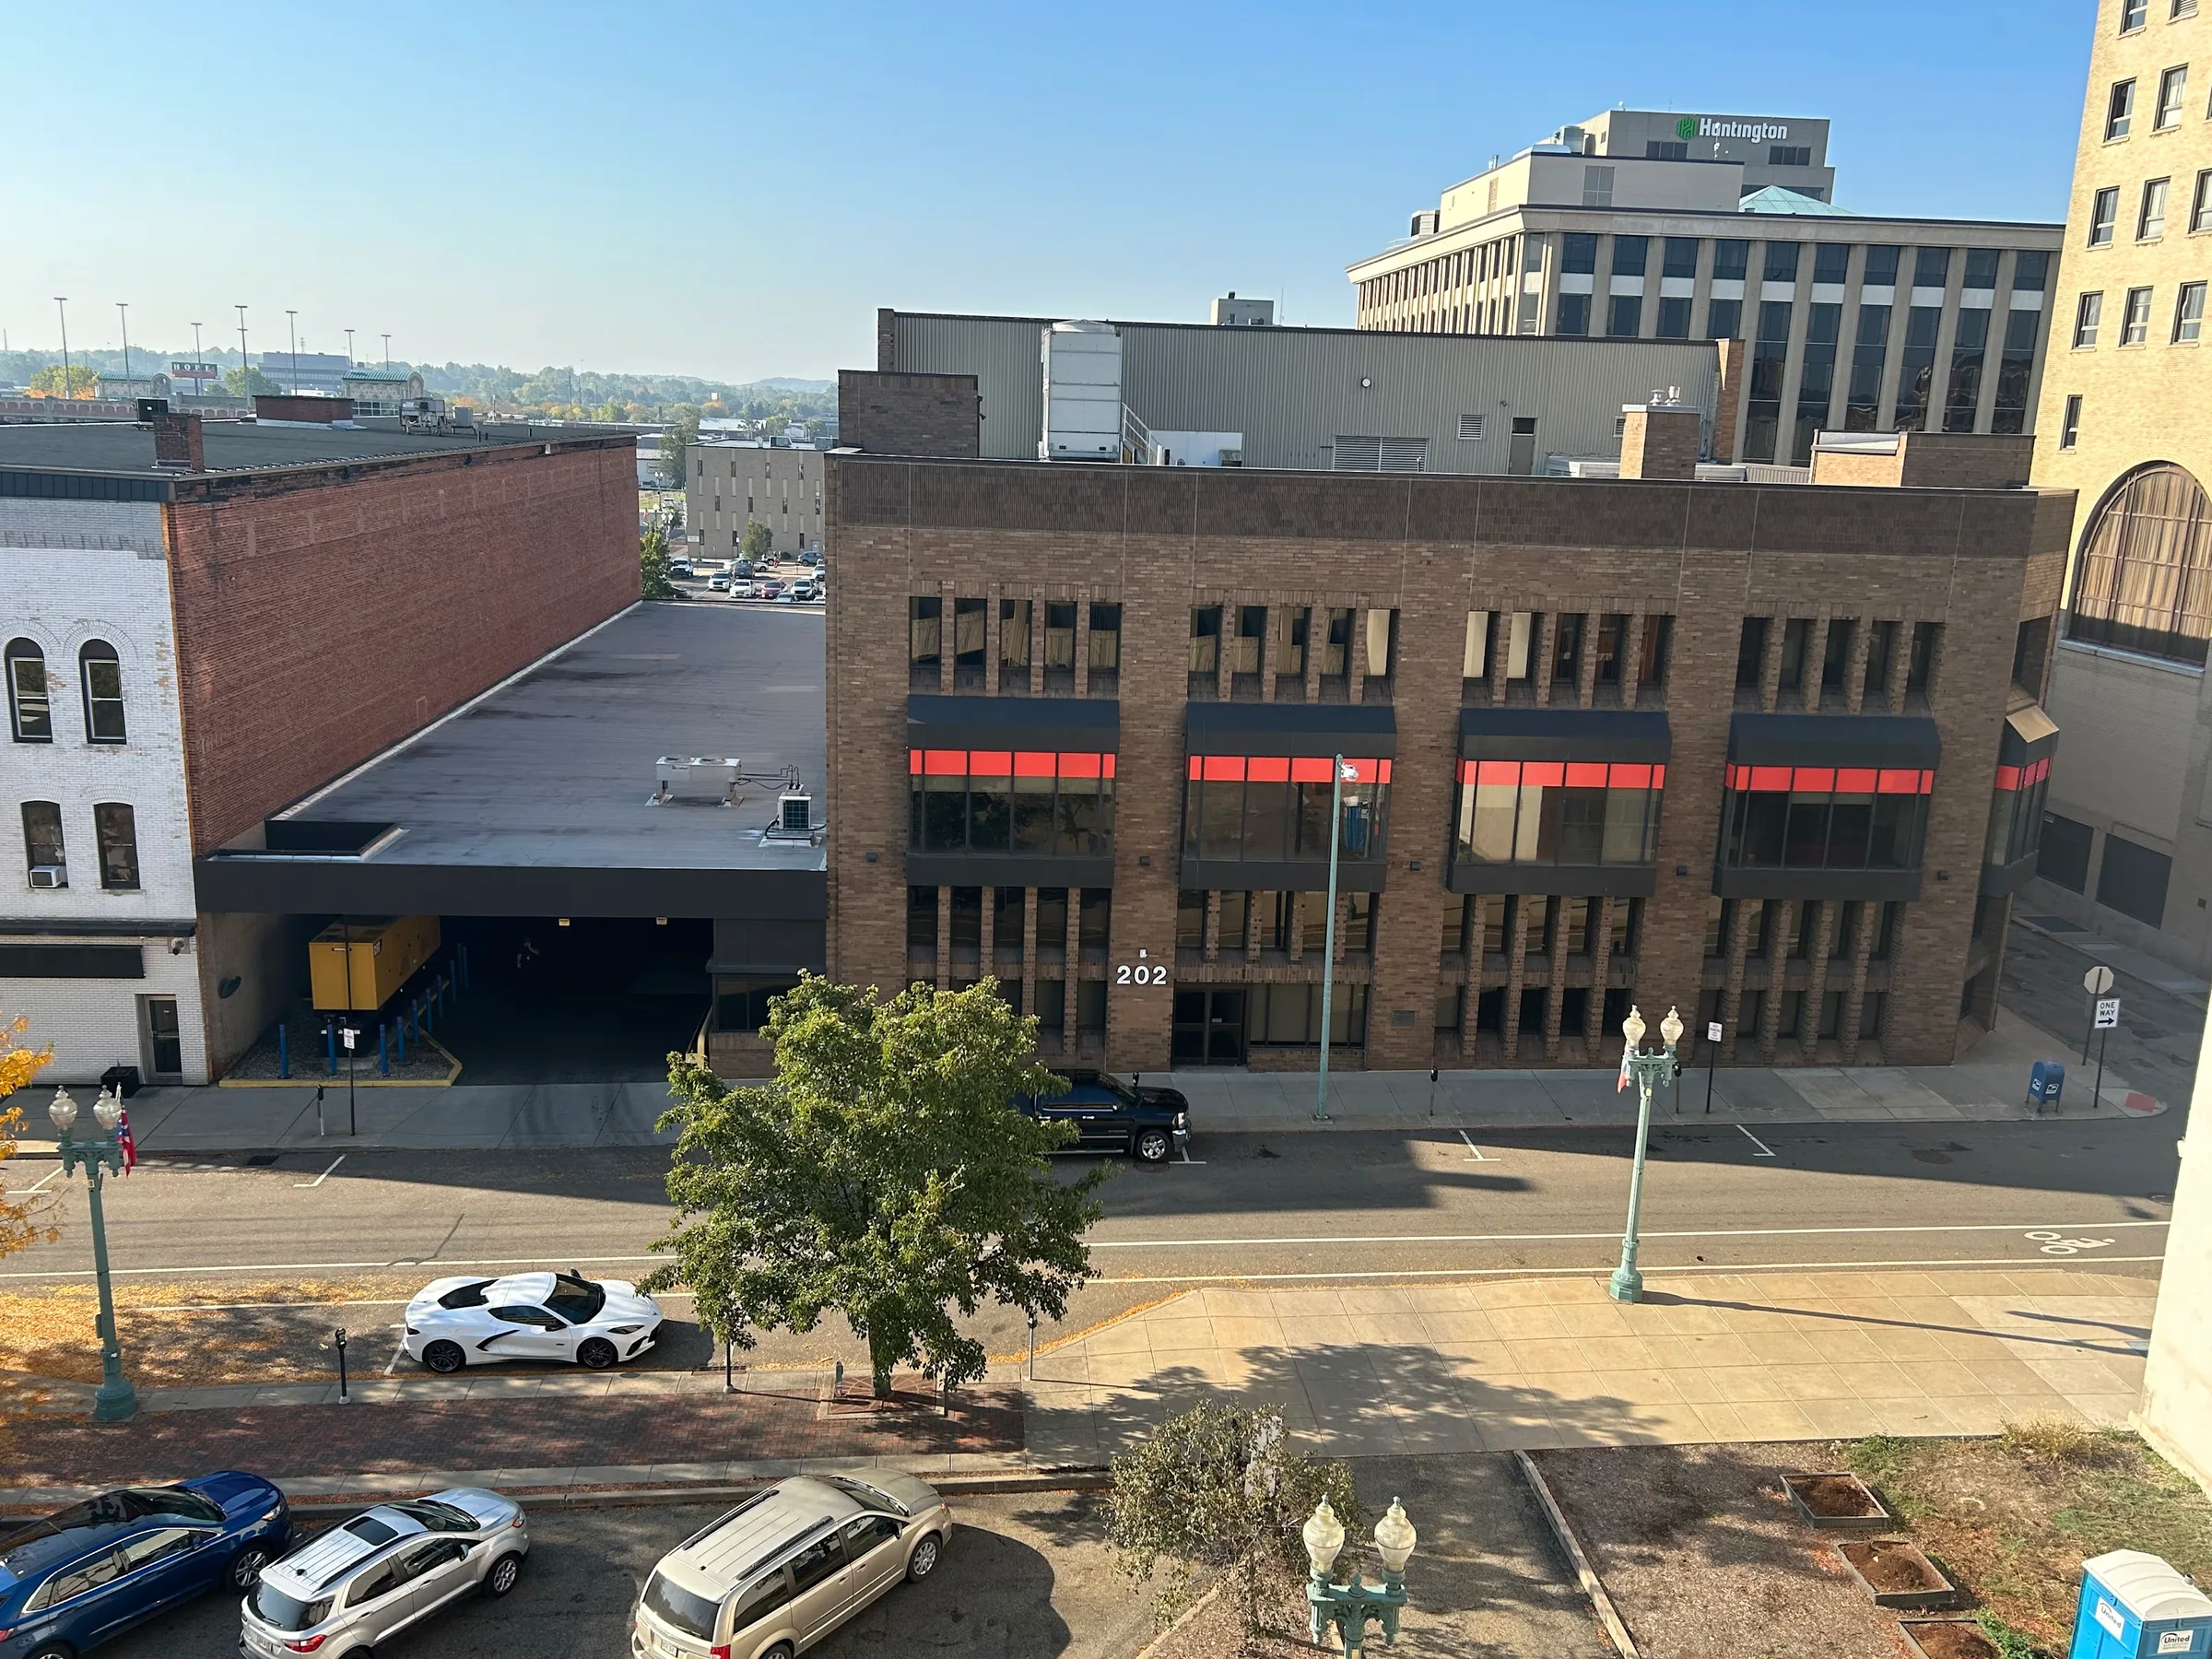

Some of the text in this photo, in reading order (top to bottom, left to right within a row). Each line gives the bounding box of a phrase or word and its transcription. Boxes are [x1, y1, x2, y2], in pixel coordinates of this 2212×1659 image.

[1699, 118, 1788, 143] Huntington
[1116, 965, 1167, 985] 202
[2100, 1606, 2122, 1629] United
[2164, 1635, 2190, 1643] United
